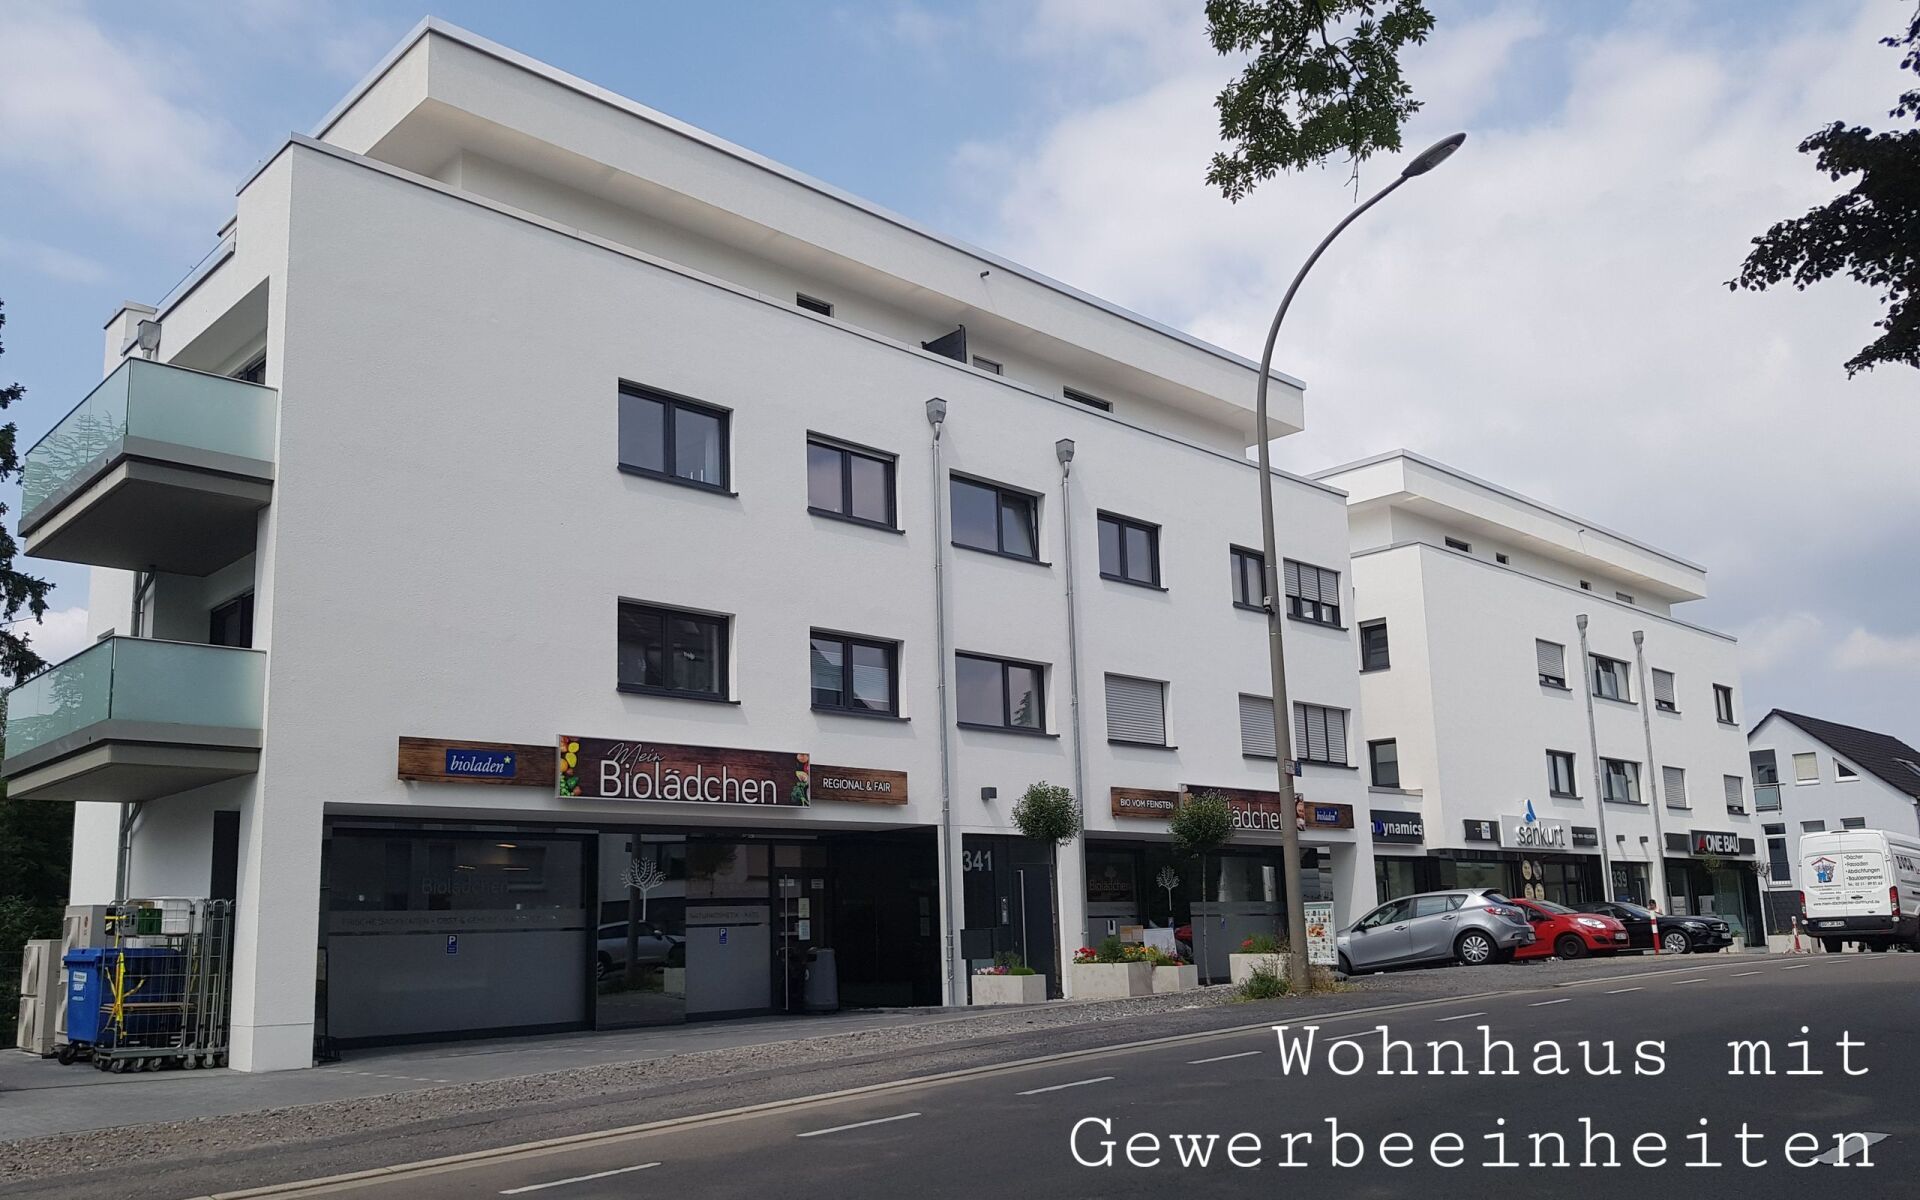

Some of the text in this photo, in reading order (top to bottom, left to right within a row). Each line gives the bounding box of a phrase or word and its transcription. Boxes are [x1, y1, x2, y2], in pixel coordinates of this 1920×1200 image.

[607, 742, 666, 766] Mein
[450, 755, 504, 773] bioladen
[600, 759, 777, 805] Biolädchen
[823, 778, 891, 793] REGIONAL & FAIR
[1120, 798, 1174, 810] BIO VOM FEINSTEN
[1519, 821, 1565, 848] sankurt
[1706, 834, 1724, 852] ONE
[1723, 835, 1740, 853] BAU
[962, 850, 992, 872] 341
[1612, 870, 1628, 888] 339
[1847, 867, 1880, 875] Abdichtungen
